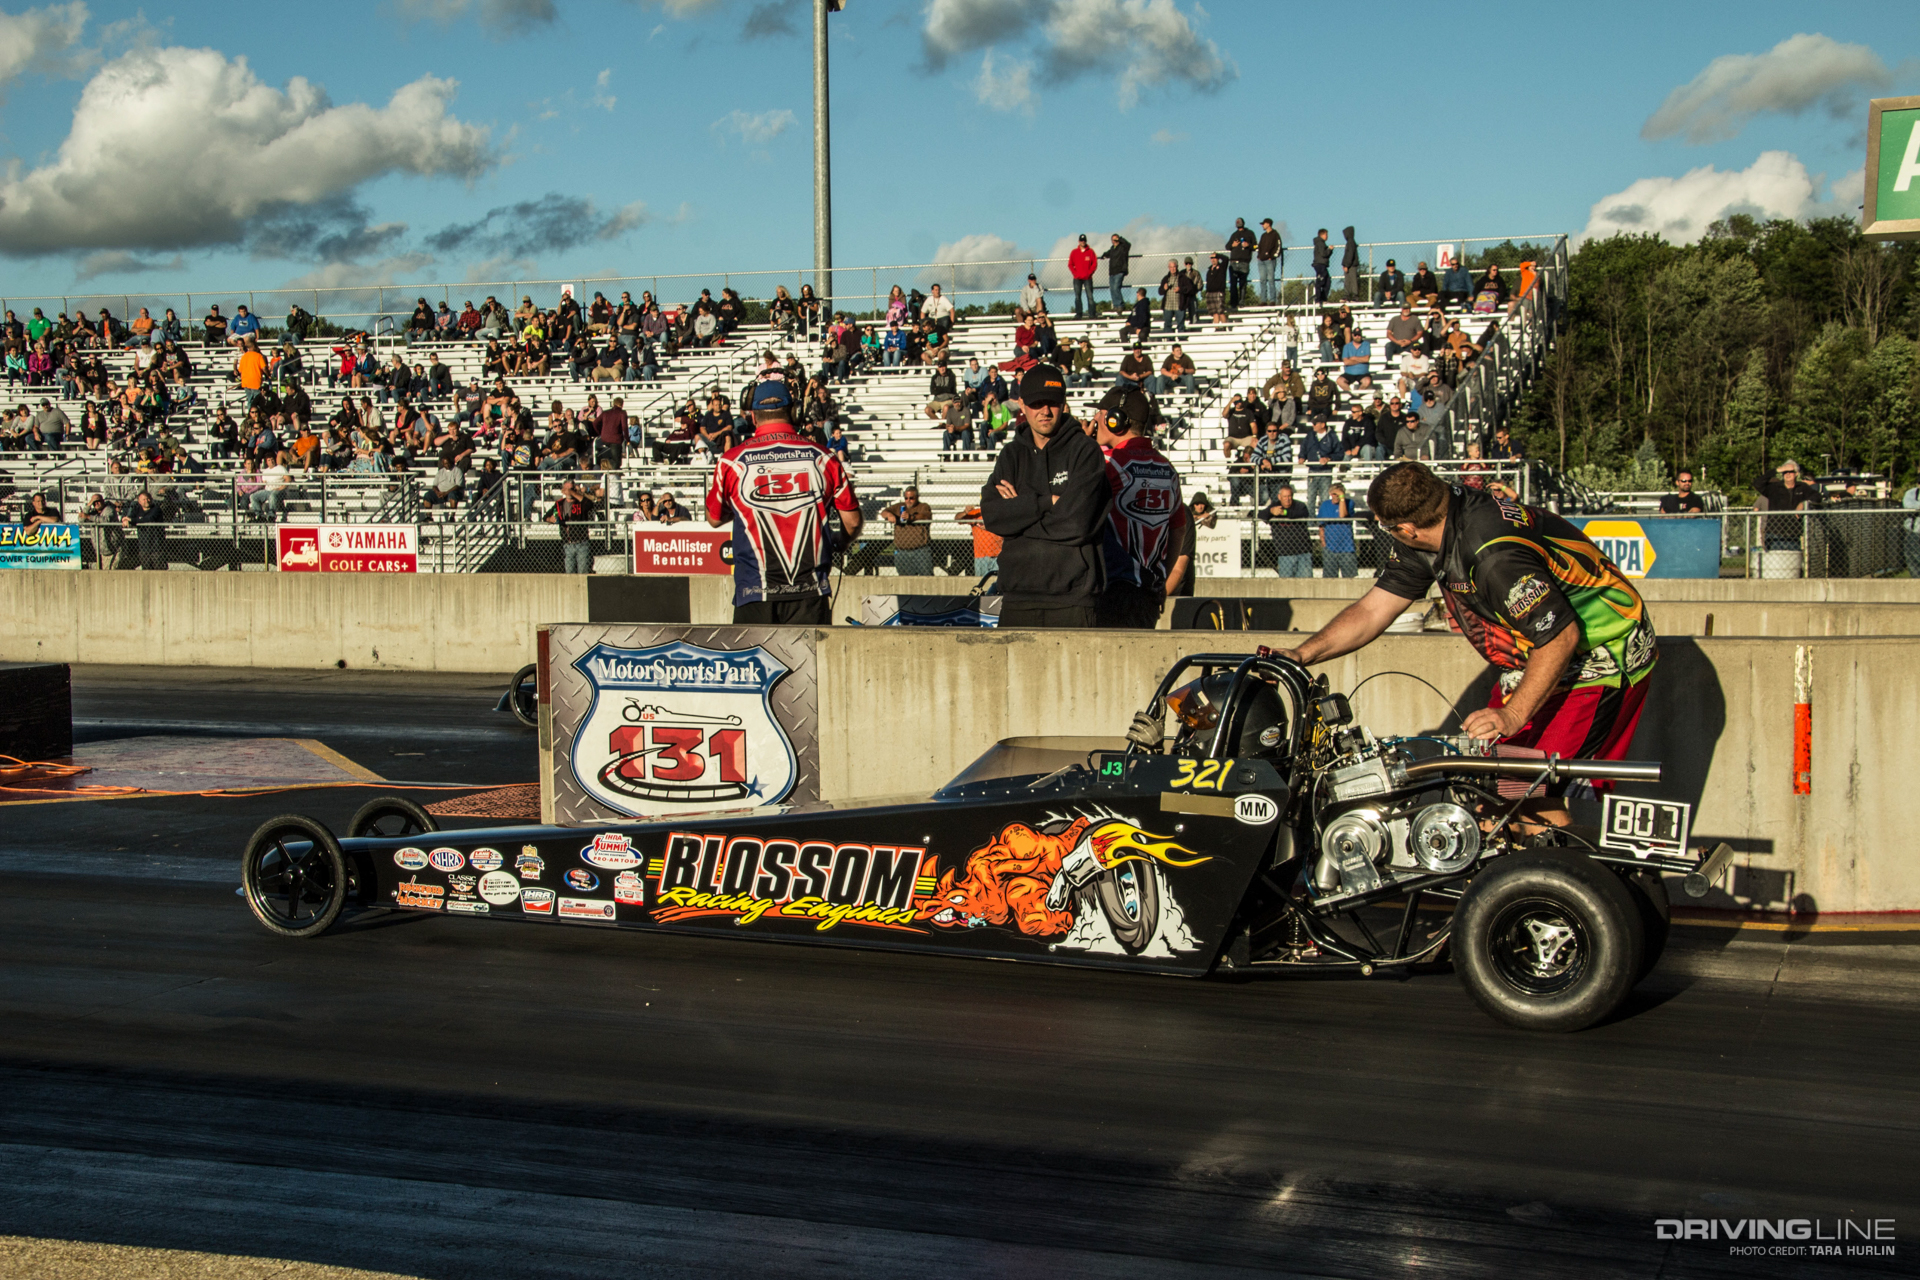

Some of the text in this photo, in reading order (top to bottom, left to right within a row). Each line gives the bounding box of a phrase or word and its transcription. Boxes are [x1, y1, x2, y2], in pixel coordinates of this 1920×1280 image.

[744, 449, 815, 462] MotorSportsPark
[754, 471, 811, 497] 131
[346, 531, 407, 550] YAMAHA
[643, 538, 713, 553] MacAllister
[26, 555, 71, 563] EQUIPMENT
[329, 559, 363, 571] GOLF
[653, 554, 703, 566] Rentals
[1508, 581, 1550, 618] BLOSSOM
[597, 658, 762, 684] MotorSportsPark
[609, 725, 747, 783] 131
[1101, 761, 1123, 776] J3
[1170, 758, 1235, 791] 321
[1240, 801, 1268, 817] MM
[1614, 800, 1679, 839] 807
[435, 852, 461, 867] NHRA
[448, 874, 476, 882] CLASSIC
[656, 832, 926, 911] BLOSSOM
[399, 883, 445, 895] ROCKFORD
[525, 890, 551, 898] IHRA
[399, 896, 444, 908] HOCKEY
[657, 887, 919, 931] Racing Engines
